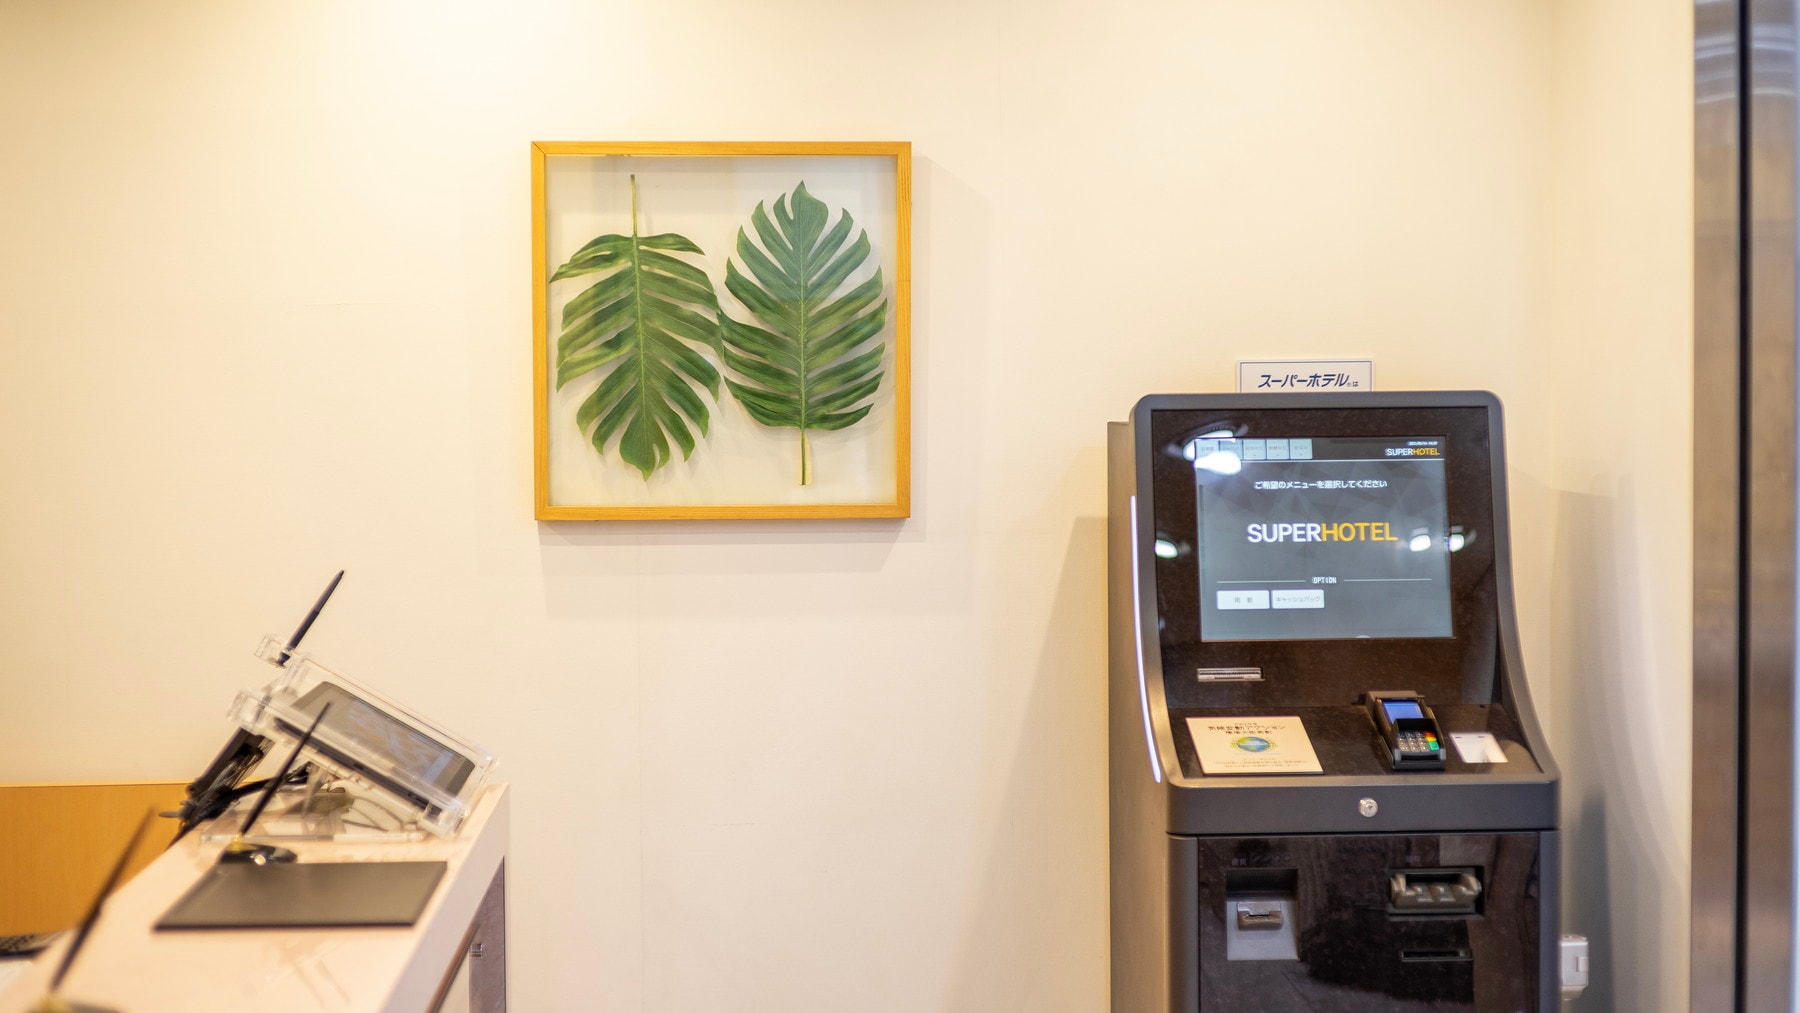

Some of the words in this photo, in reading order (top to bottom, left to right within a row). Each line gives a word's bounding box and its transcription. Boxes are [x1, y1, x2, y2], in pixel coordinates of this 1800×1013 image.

[1386, 447, 1440, 456] SUPERHOTEL
[1254, 480, 1388, 490] ご希望のメニューを選択してください
[1247, 522, 1399, 543] SUPERHOTEL
[1312, 576, 1337, 584] OPTION
